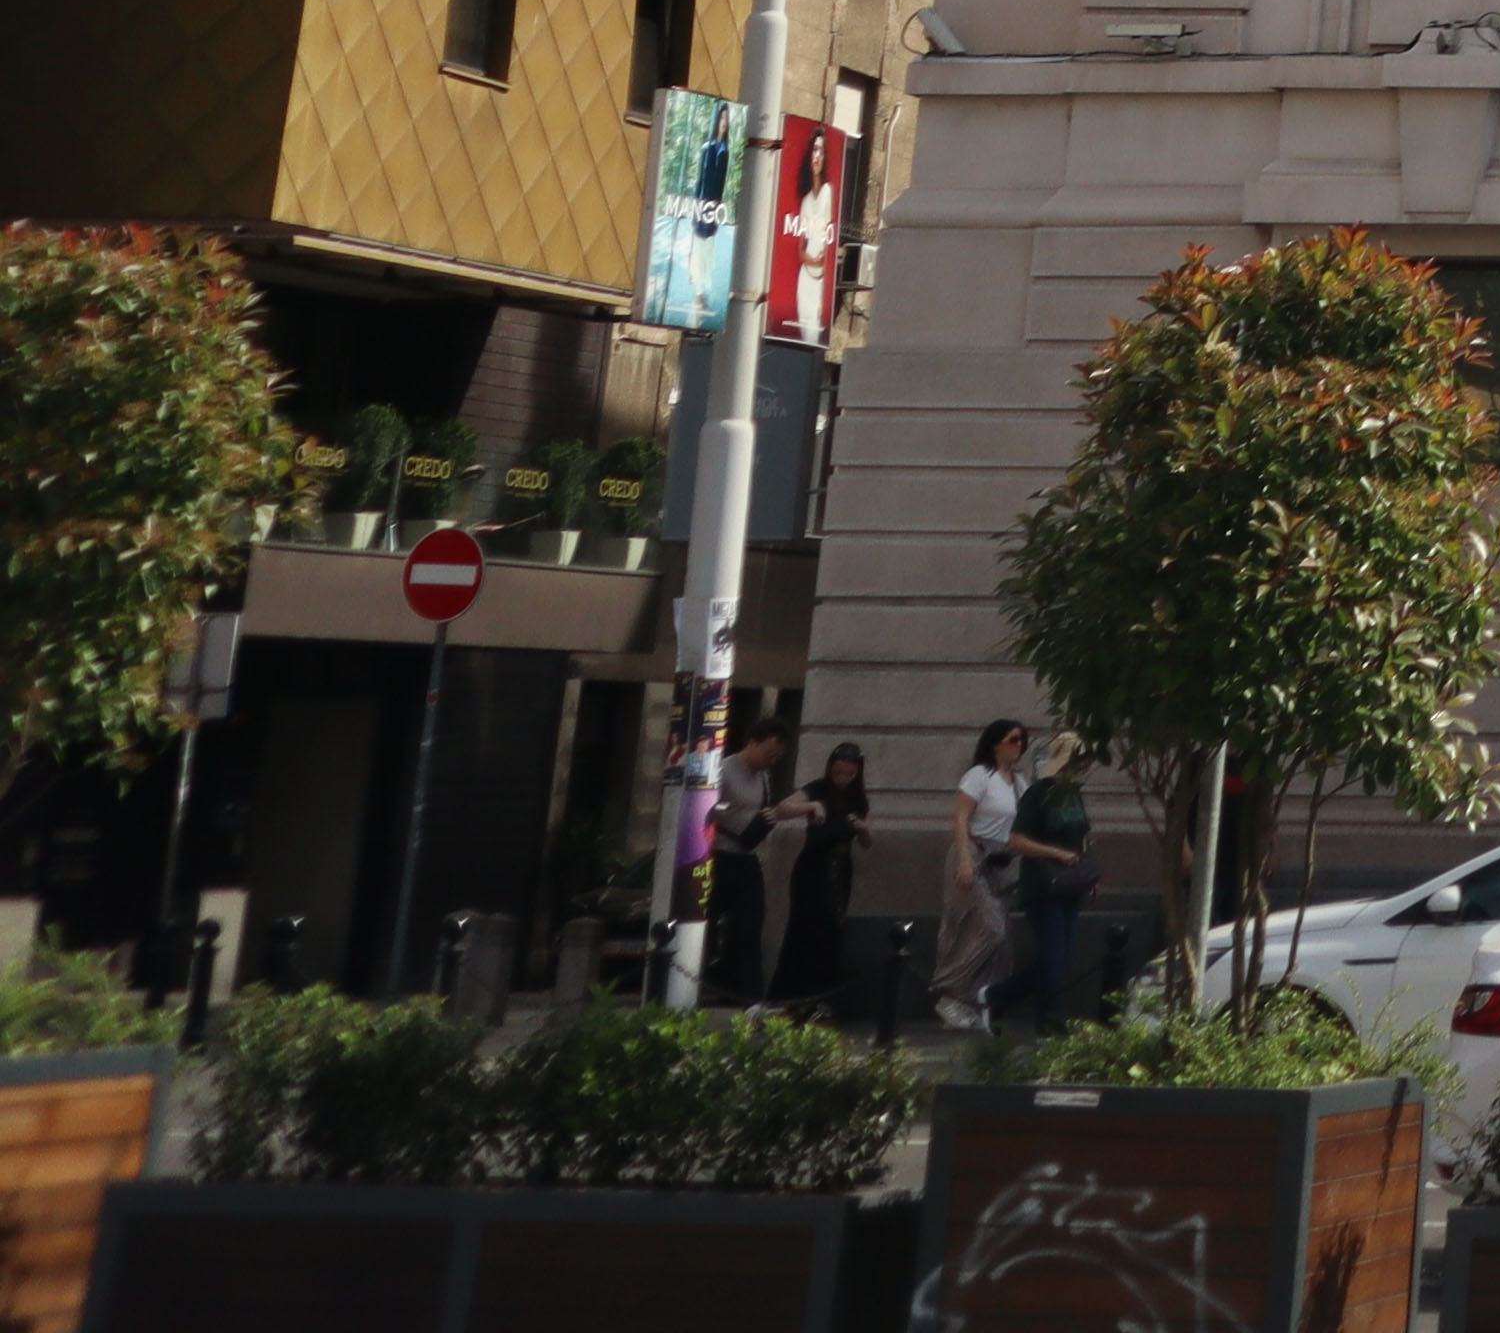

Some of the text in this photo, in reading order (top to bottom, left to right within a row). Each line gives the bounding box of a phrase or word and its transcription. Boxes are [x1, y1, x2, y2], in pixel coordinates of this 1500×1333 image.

[665, 194, 728, 225] MANGO
[783, 213, 834, 245] MAO
[404, 456, 451, 480] CREDO
[505, 468, 549, 491] CREDO
[600, 479, 640, 500] CREDO
